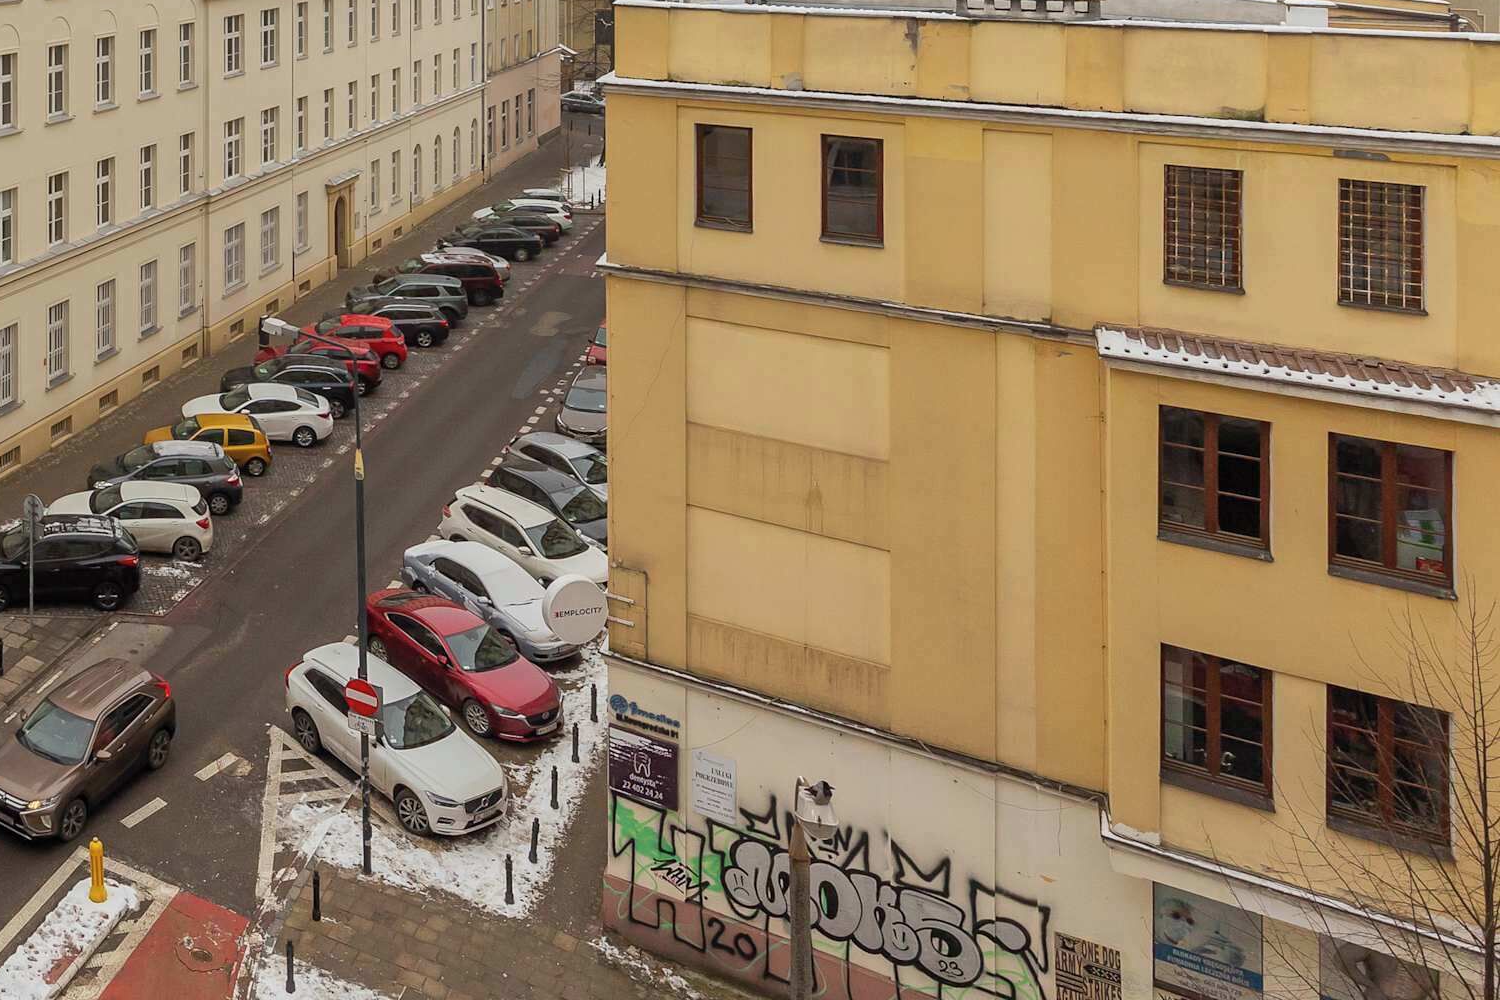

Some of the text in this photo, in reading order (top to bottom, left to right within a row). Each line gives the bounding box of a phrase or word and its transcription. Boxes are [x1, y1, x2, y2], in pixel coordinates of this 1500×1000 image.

[707, 911, 758, 961] 20
[938, 960, 964, 977] 23
[1055, 949, 1082, 977] ARMY
[1081, 939, 1121, 970] ONE DOG
[1083, 976, 1122, 1000] STRIKES
